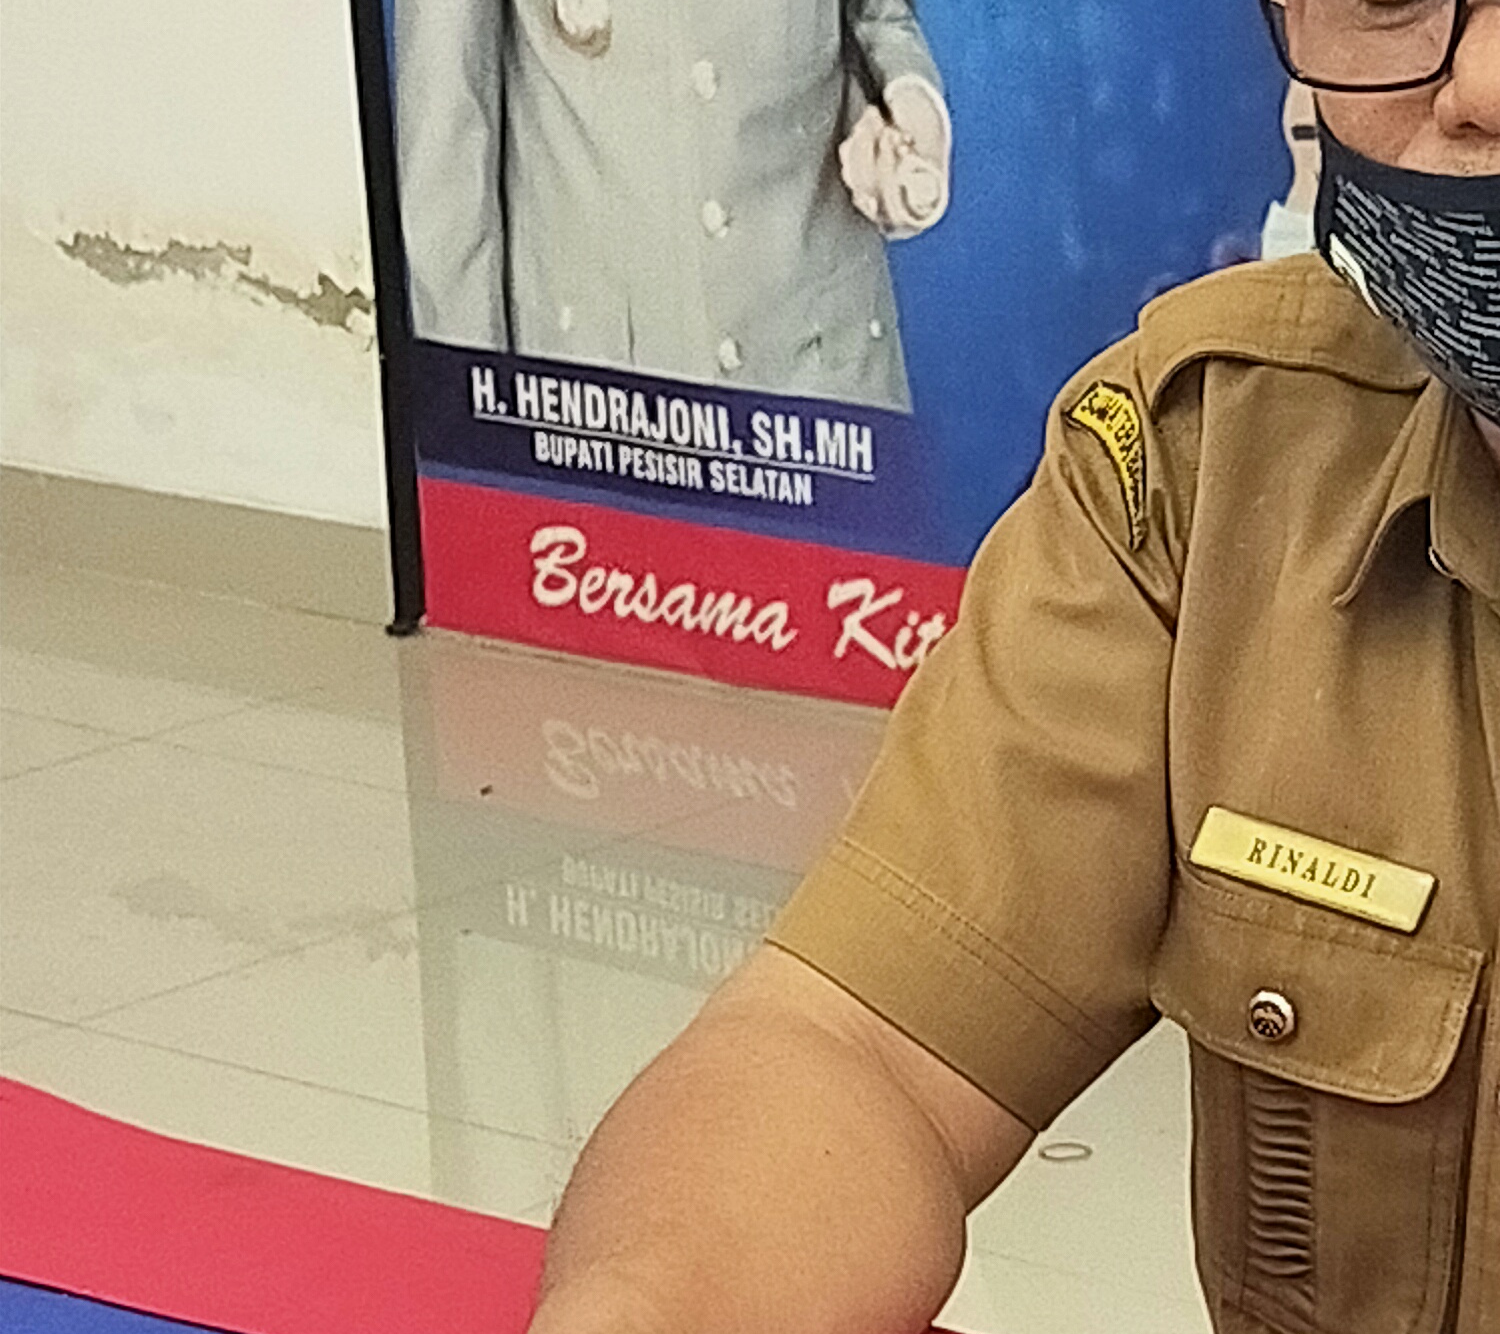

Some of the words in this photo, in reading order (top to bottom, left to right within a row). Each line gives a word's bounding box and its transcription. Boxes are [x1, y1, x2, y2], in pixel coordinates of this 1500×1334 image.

[471, 367, 507, 414] H.
[515, 372, 743, 455] HENDRAJONI,
[752, 411, 872, 473] SH.MH
[534, 431, 615, 473] BUPATI
[619, 444, 704, 490] PESISIR
[710, 461, 813, 505] SELATAN
[530, 525, 799, 651] Bersama
[1246, 837, 1377, 899] RINALDI
